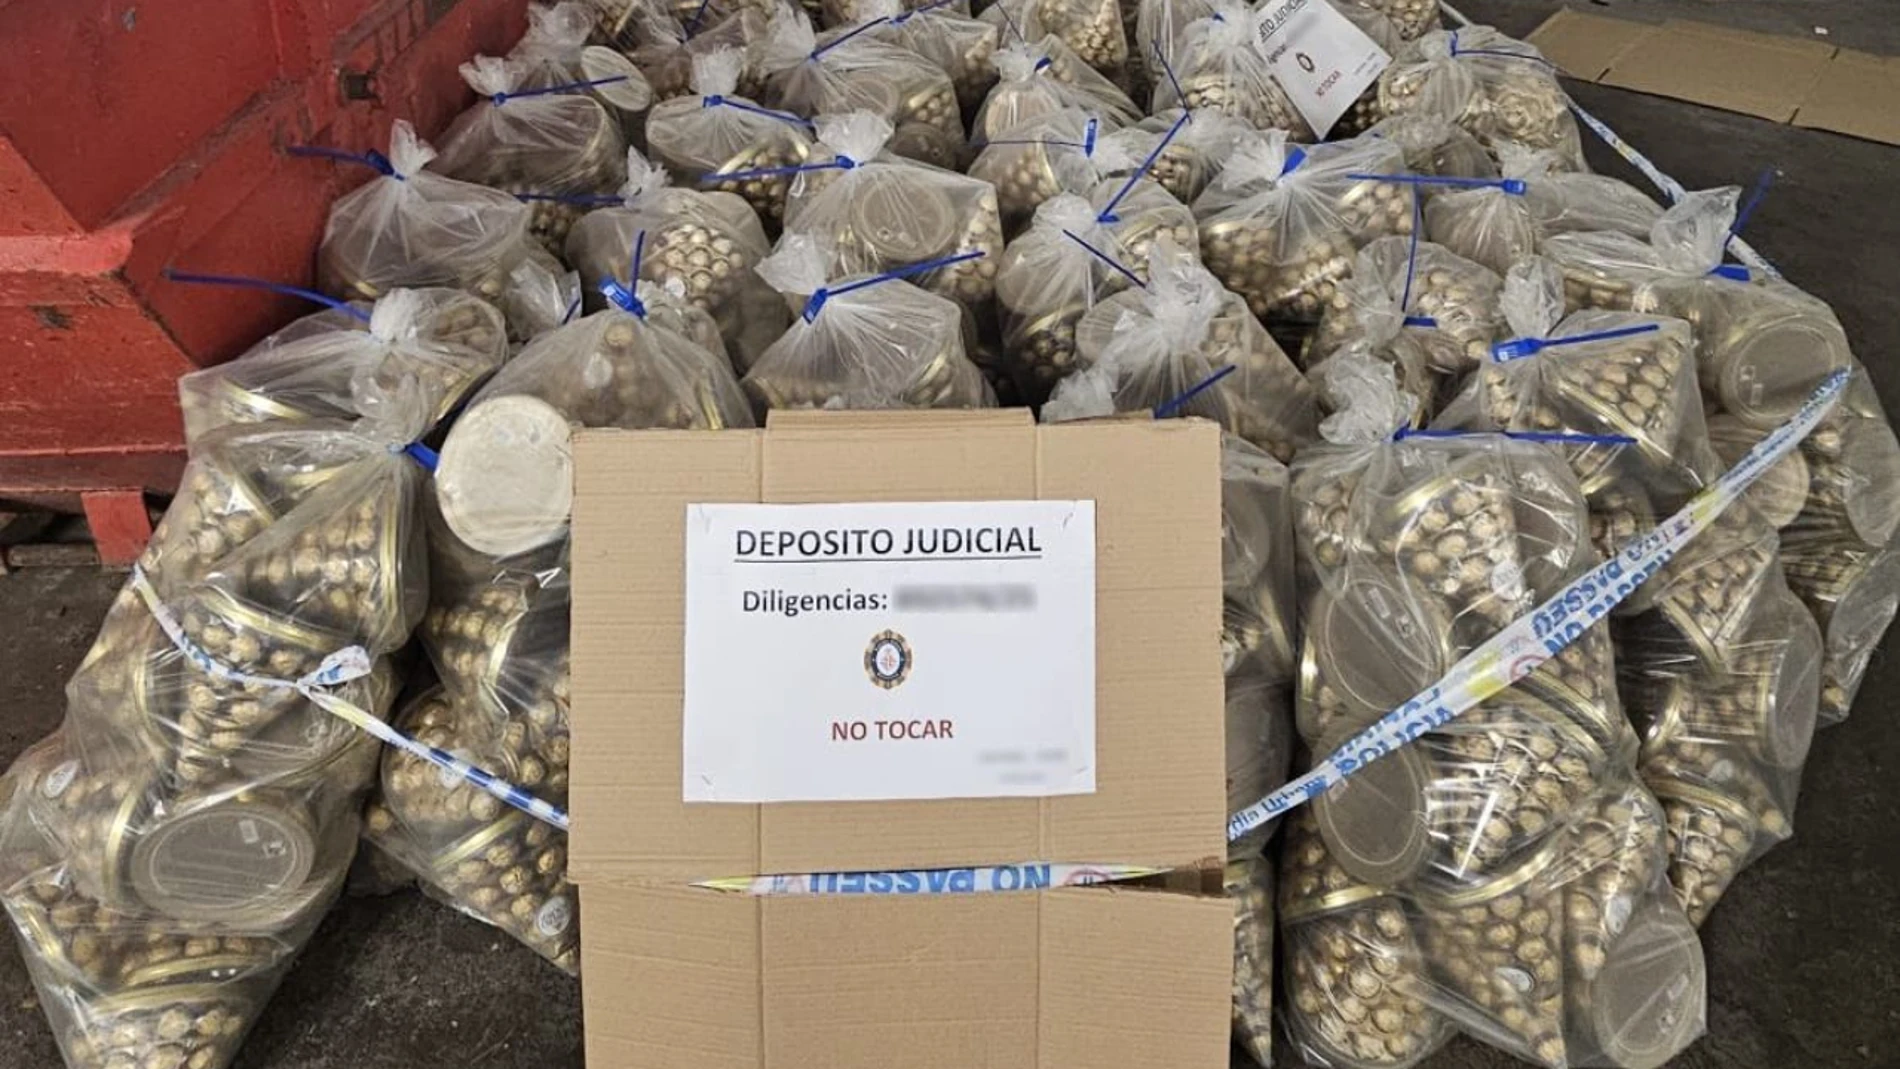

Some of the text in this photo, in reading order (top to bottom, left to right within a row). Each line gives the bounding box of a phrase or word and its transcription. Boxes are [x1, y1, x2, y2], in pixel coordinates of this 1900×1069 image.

[736, 526, 1042, 557] DEPOSITO JUDICIAL
[742, 588, 888, 617] Diligencias:
[831, 719, 954, 741] NO TOCAR
[808, 864, 1051, 894] NO PASSEU
